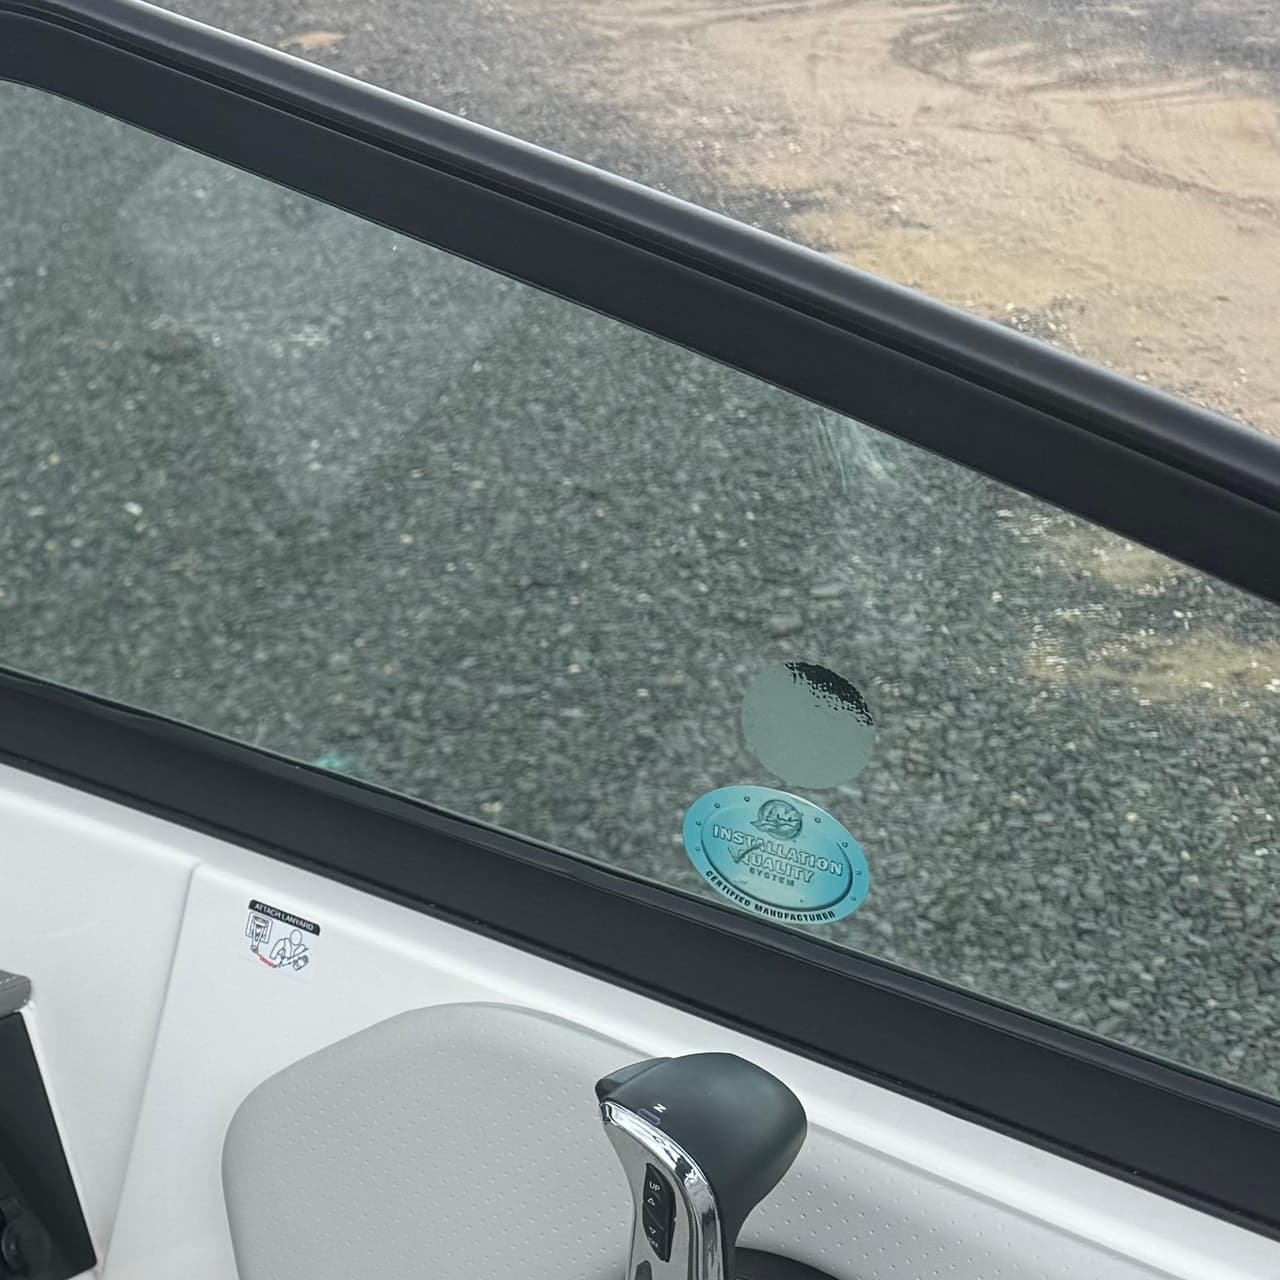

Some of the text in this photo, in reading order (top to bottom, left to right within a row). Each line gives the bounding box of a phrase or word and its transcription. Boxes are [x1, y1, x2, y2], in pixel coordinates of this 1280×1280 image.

[711, 823, 844, 877] INSTALLATION
[705, 870, 837, 923] CERTIFIED MANUFACTURER
[254, 902, 314, 932] ATTACH LANYARD
[653, 1103, 667, 1113] N
[649, 1180, 661, 1192] UP
